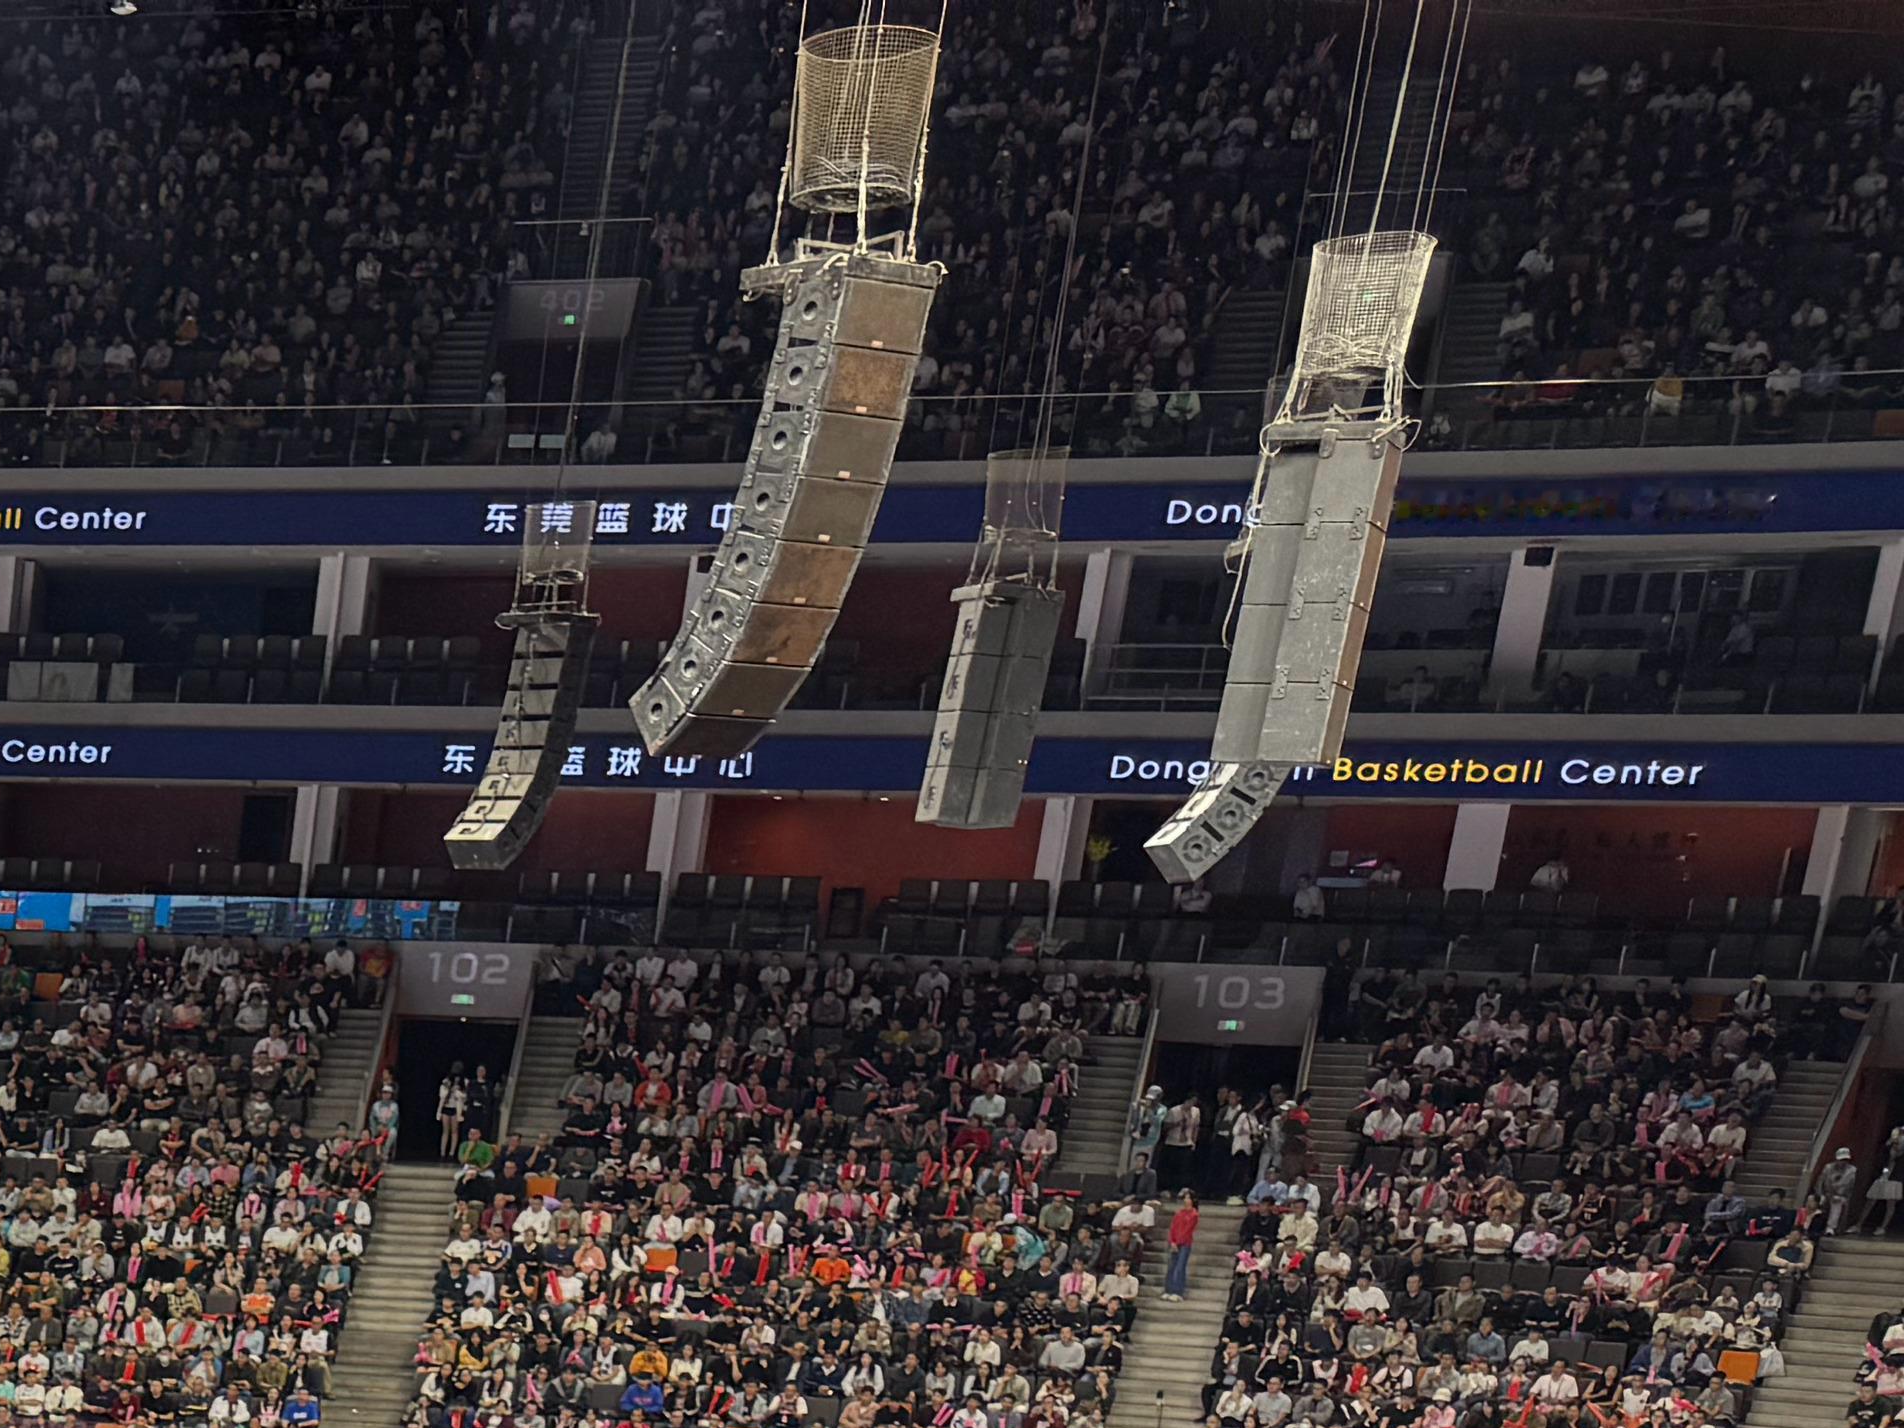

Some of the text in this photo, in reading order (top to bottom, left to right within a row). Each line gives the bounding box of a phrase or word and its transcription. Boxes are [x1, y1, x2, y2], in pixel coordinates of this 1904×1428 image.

[34, 506, 147, 532] Center
[1, 740, 112, 765] Center
[442, 744, 753, 778] 东篮球中心
[1333, 757, 1703, 787] Basketball Center
[429, 952, 510, 985] 102
[1193, 974, 1286, 1010] 103
